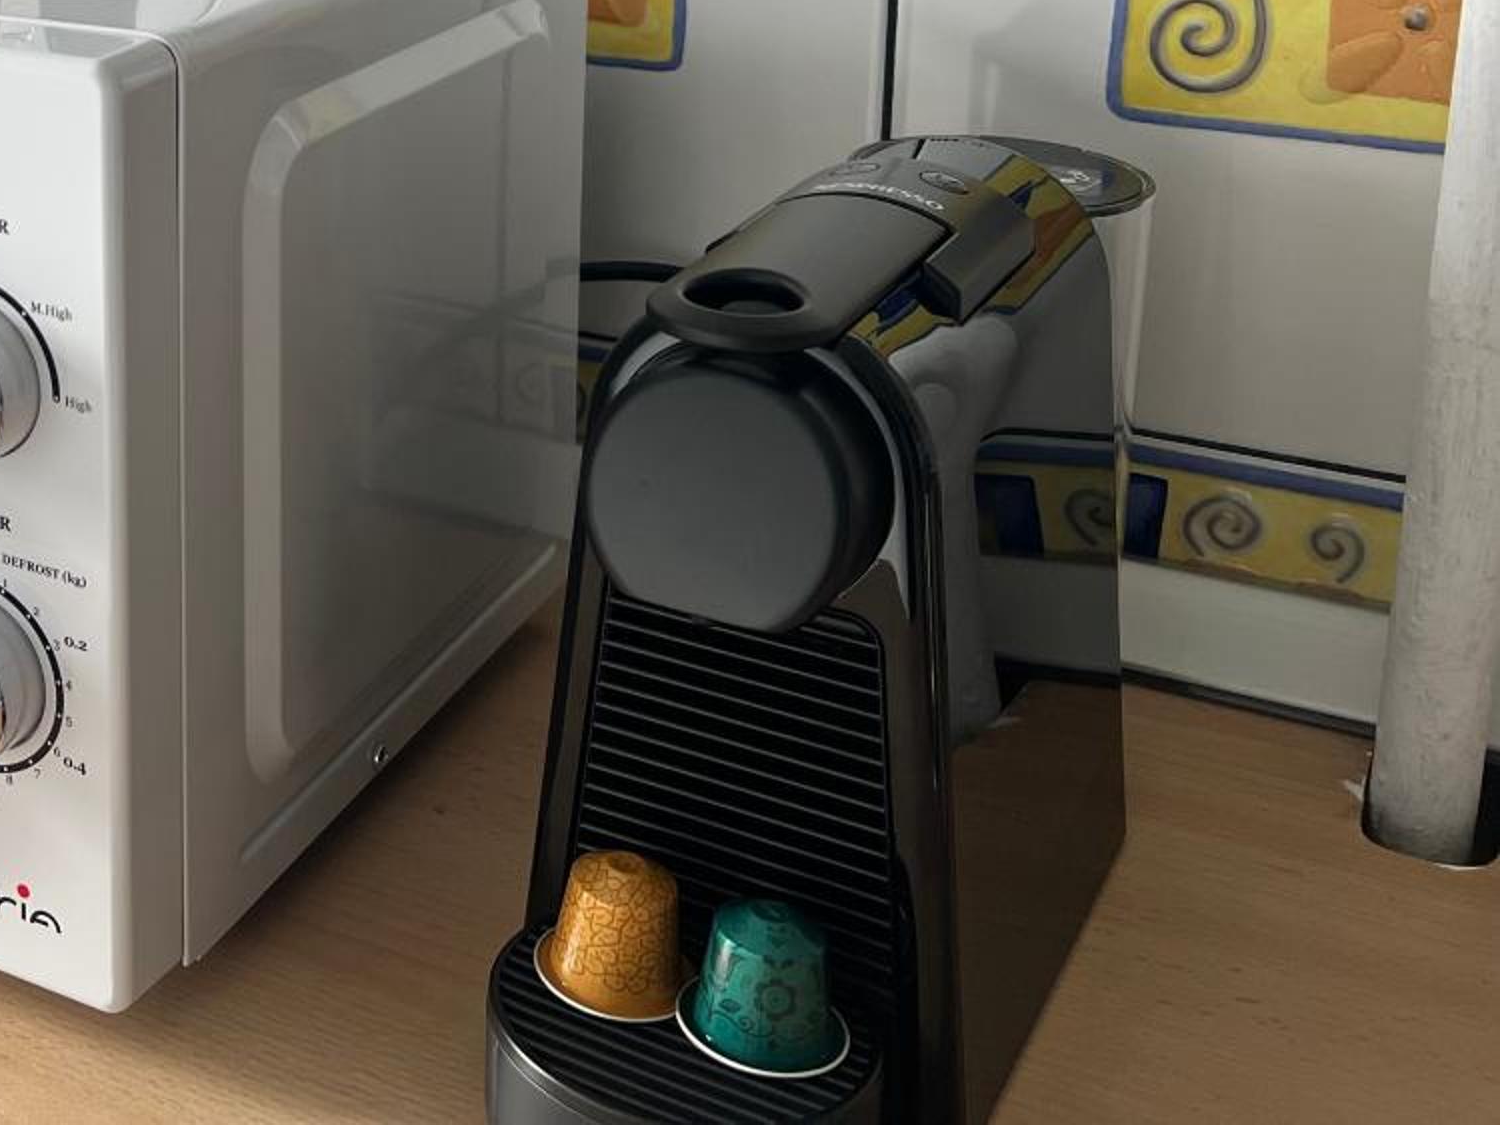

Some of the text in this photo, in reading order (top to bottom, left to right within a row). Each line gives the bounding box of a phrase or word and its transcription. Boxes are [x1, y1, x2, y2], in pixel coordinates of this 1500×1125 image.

[30, 301, 73, 322] M.High
[64, 395, 92, 414] High
[2, 552, 59, 580] DEFROST
[63, 636, 88, 652] 0.2
[63, 756, 87, 776] 0.4
